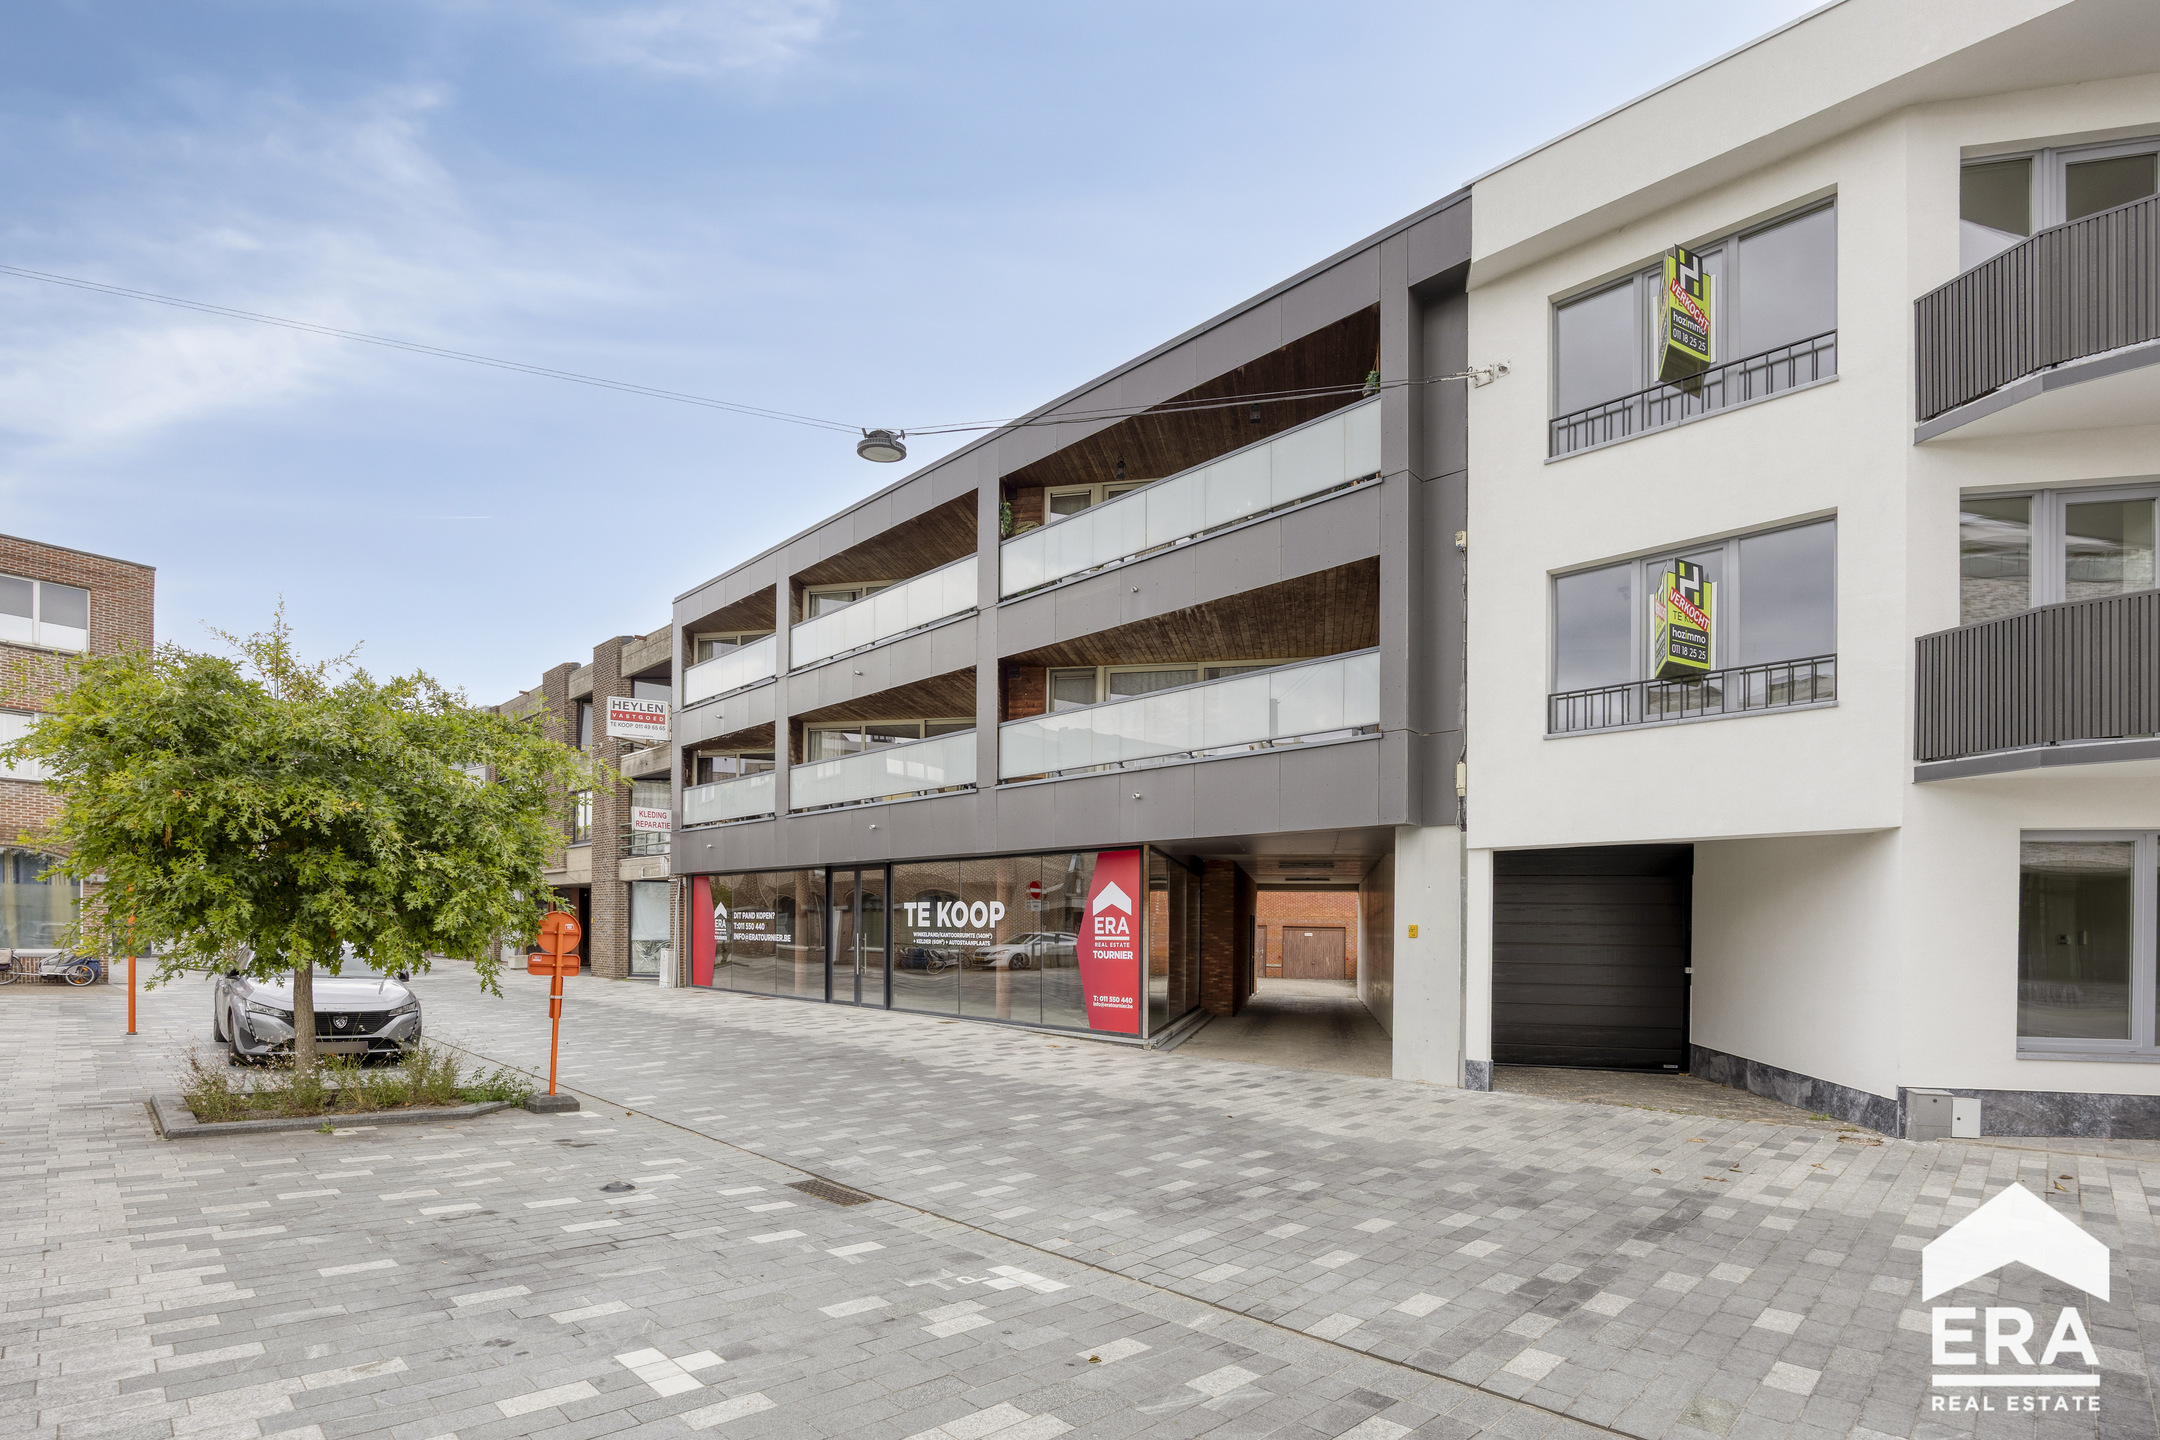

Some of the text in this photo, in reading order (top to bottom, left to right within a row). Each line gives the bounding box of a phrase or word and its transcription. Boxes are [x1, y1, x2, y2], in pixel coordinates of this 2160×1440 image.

[1671, 279, 1710, 331] VERKOCHT
[1673, 310, 1706, 335] hozimmo
[1672, 328, 1706, 351] 011 18 25 25
[1670, 588, 1710, 630] VERKOCHT
[1673, 610, 1682, 621] TE
[1672, 627, 1706, 644] hozimmo
[1672, 644, 1706, 660] 011 18 25 25
[612, 700, 664, 713] HEYLEN
[612, 713, 664, 722] VASTGOED
[639, 810, 667, 819] KLEDING
[635, 820, 671, 829] REPARATIE
[756, 912, 775, 920] KOPEN?
[904, 901, 1005, 928] TE KOOP
[715, 919, 726, 928] ERA
[1094, 916, 1130, 934] ERA
[733, 933, 791, 942] INFO@ERATOURNIER.BE
[1092, 950, 1133, 960] TOURNIER
